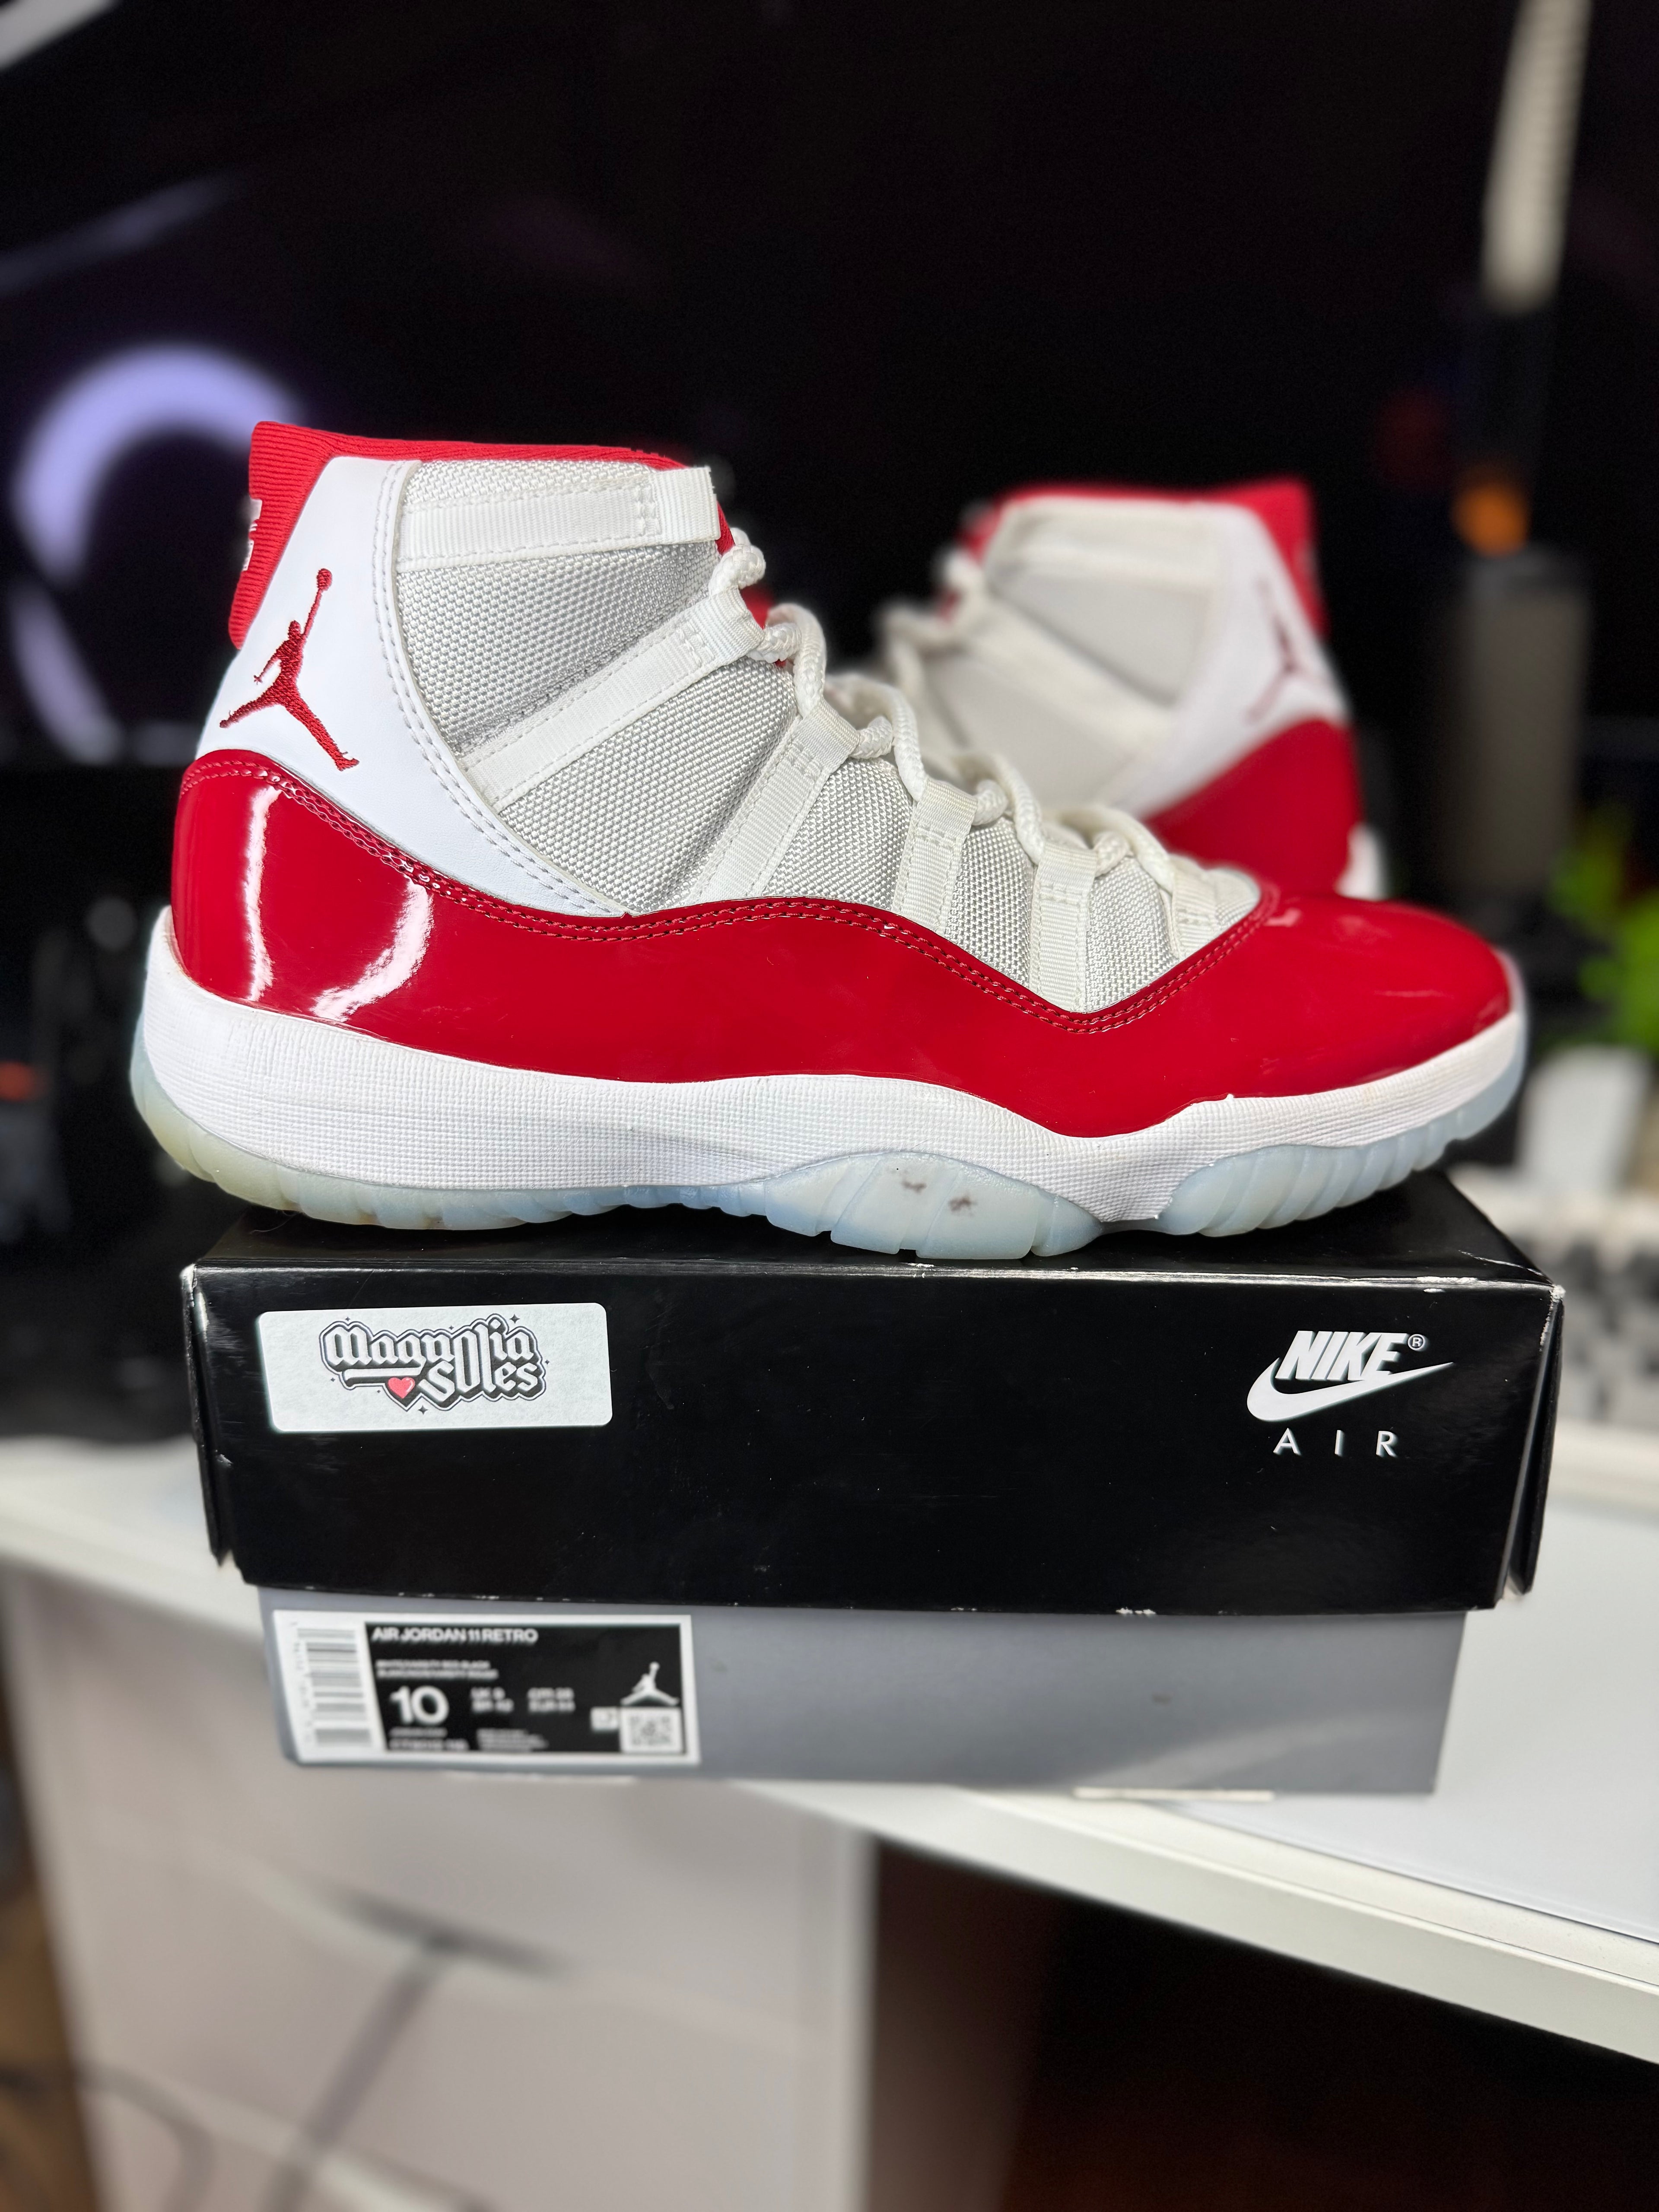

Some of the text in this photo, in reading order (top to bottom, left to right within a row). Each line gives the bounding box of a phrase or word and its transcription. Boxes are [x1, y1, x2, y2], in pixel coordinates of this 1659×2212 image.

[1273, 1427, 1398, 1458] AIR
[372, 1627, 539, 1643] AIR JORDAN 11 RETRO
[389, 1685, 450, 1725] 10
